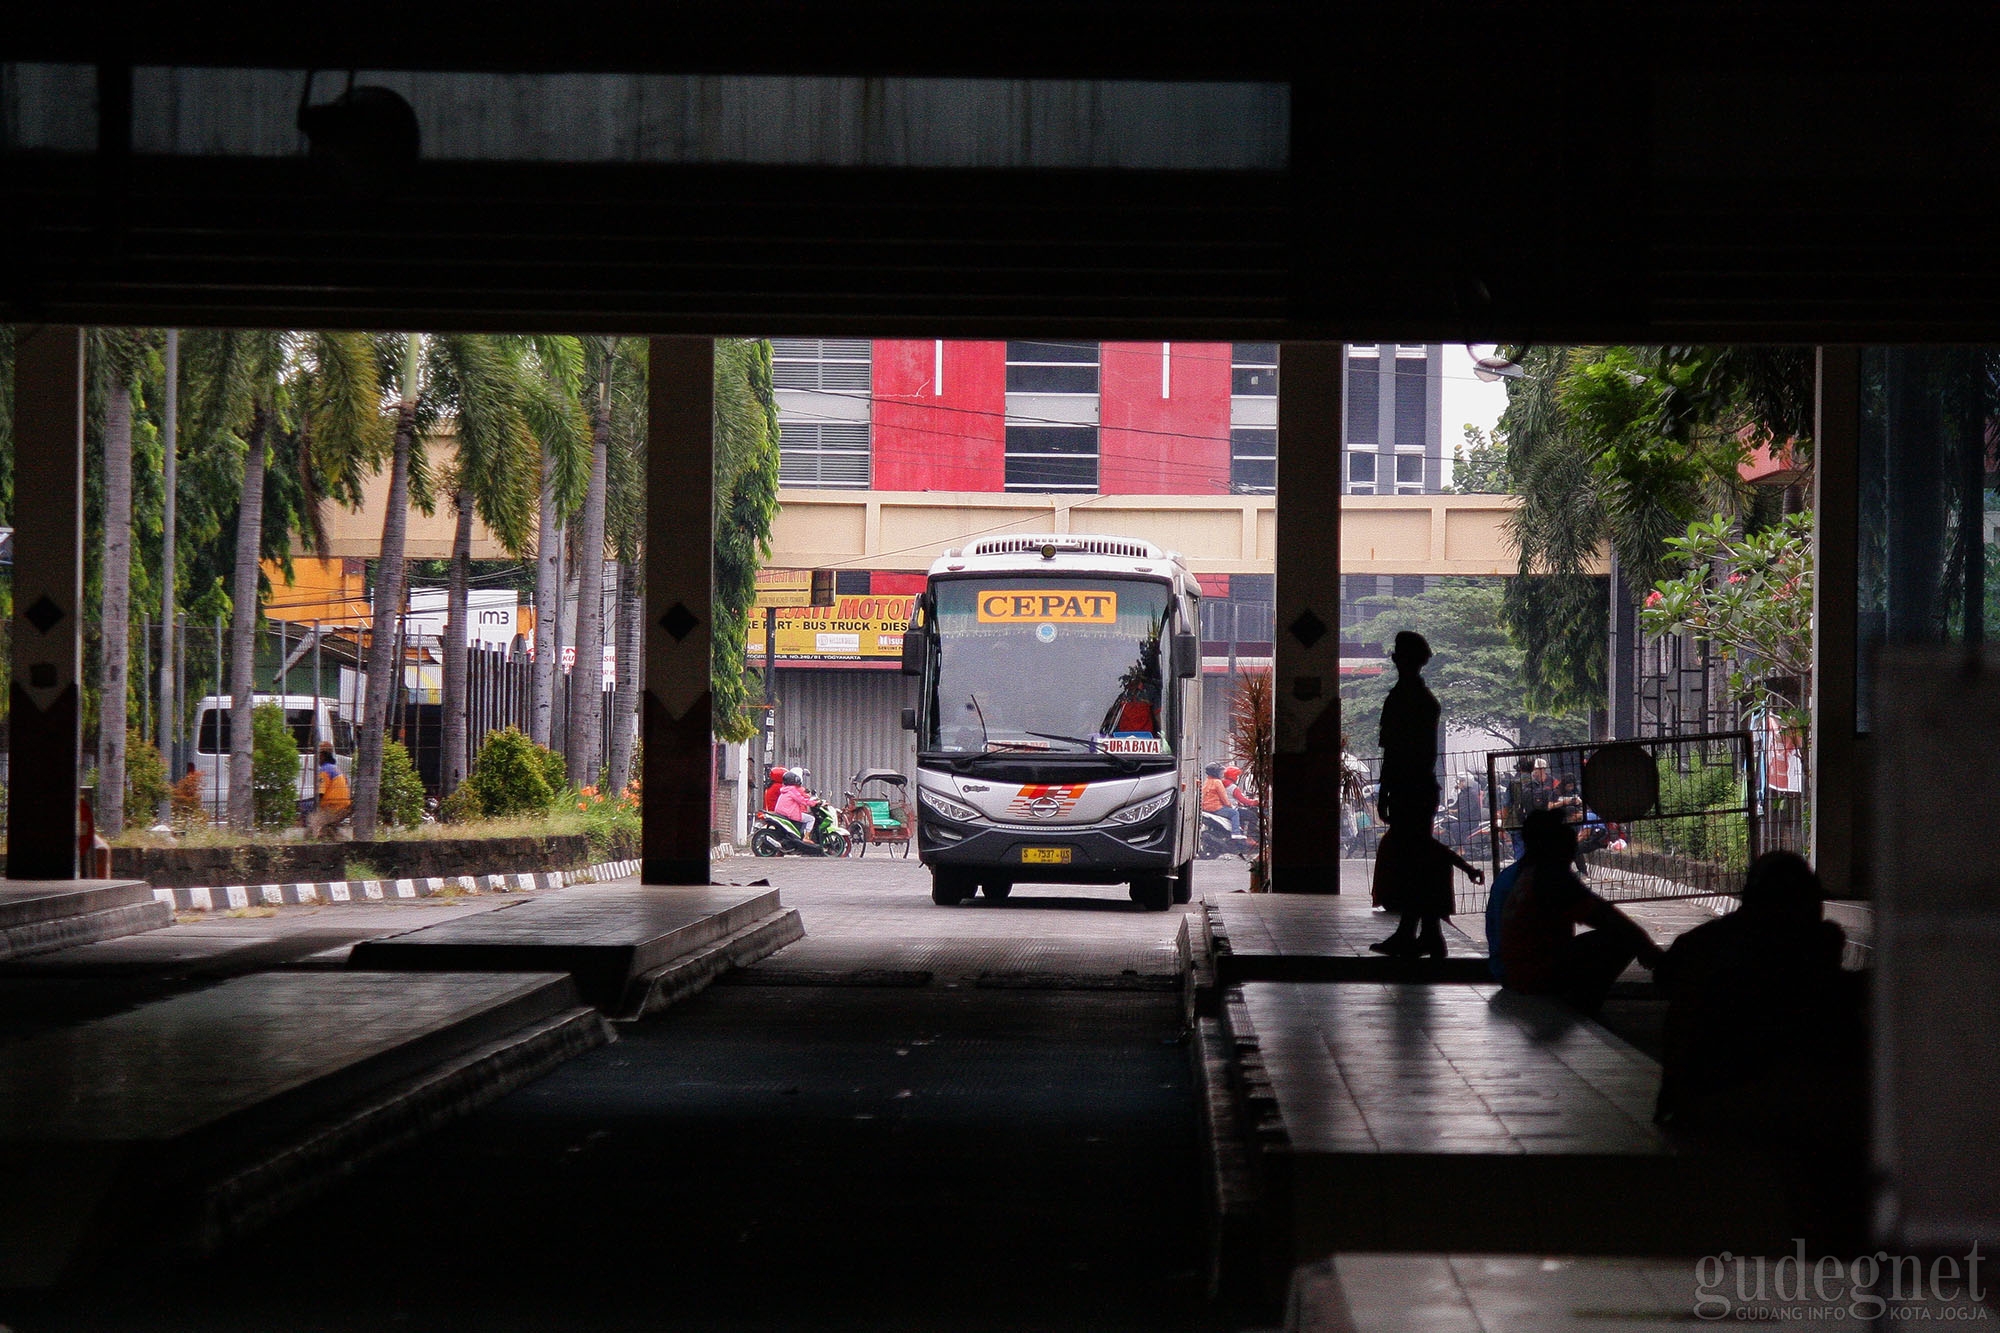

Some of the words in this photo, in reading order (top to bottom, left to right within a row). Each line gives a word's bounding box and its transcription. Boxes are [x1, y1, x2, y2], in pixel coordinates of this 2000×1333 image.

[982, 595, 1111, 618] CEPAT
[803, 621, 826, 630] BUS
[830, 621, 870, 631] TRUCK
[1102, 740, 1159, 753] SURABAYA
